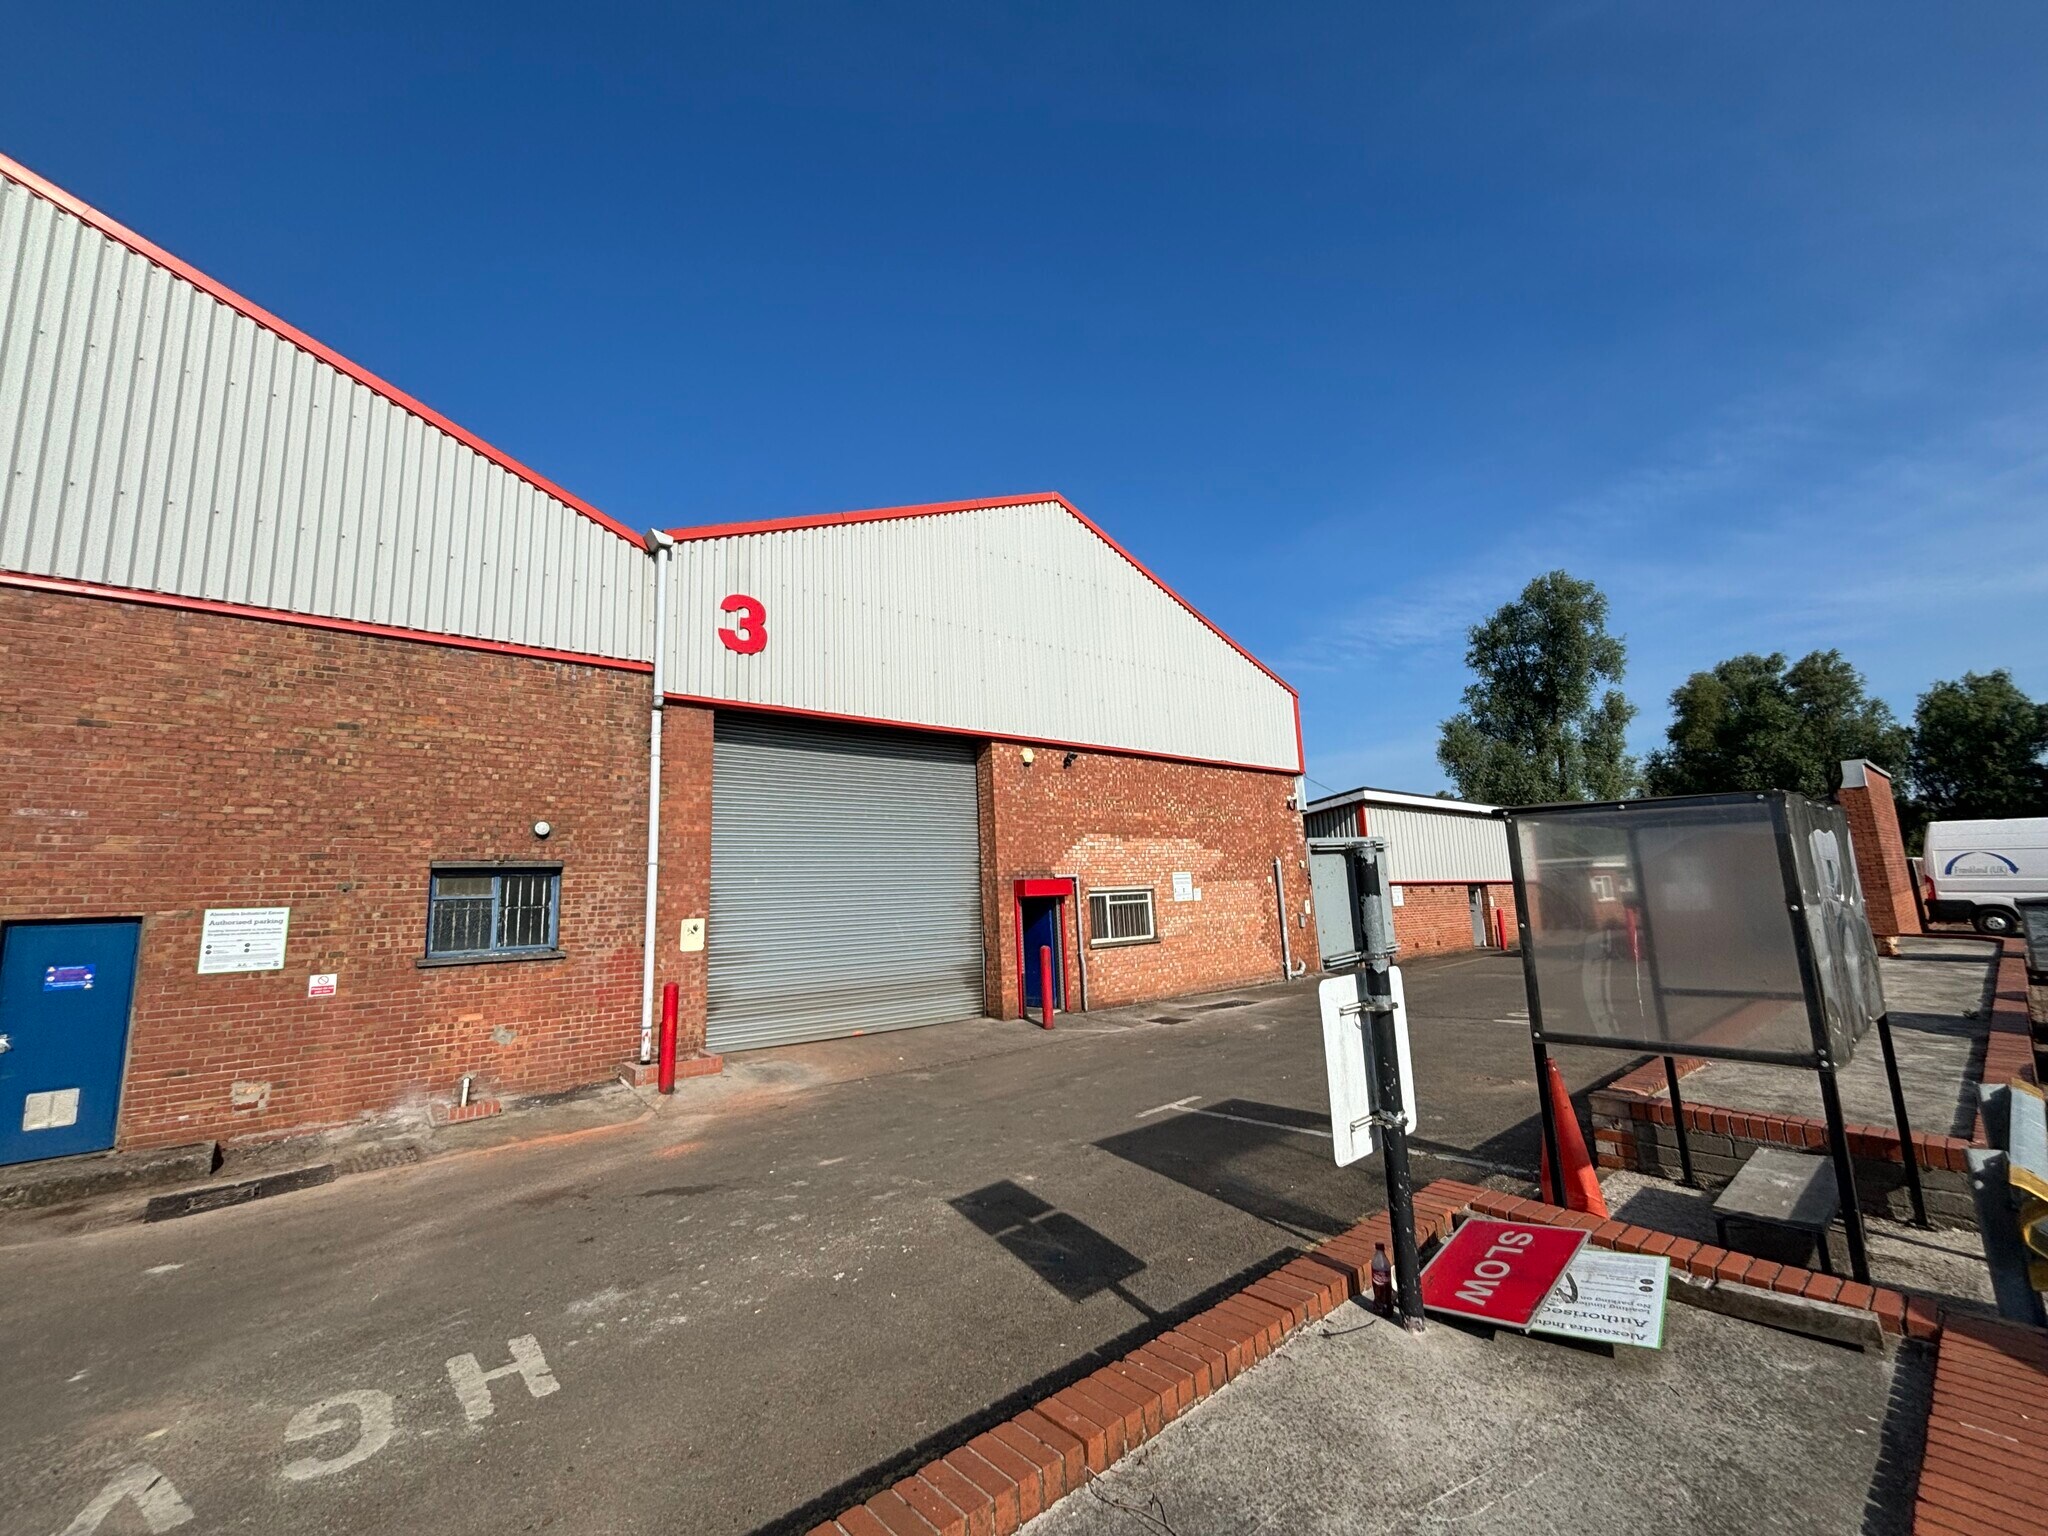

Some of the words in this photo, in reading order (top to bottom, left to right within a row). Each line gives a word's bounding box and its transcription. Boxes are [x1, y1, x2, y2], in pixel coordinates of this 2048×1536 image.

[717, 593, 767, 655] 3
[208, 919, 253, 927] Authorised
[253, 918, 284, 927] parking
[1454, 1230, 1534, 1307] SLOW
[1595, 1296, 1634, 1307] parking
[1609, 1303, 1650, 1315] Loading
[1569, 1323, 1648, 1341] Alexandra
[48, 1332, 562, 1536] HGV
